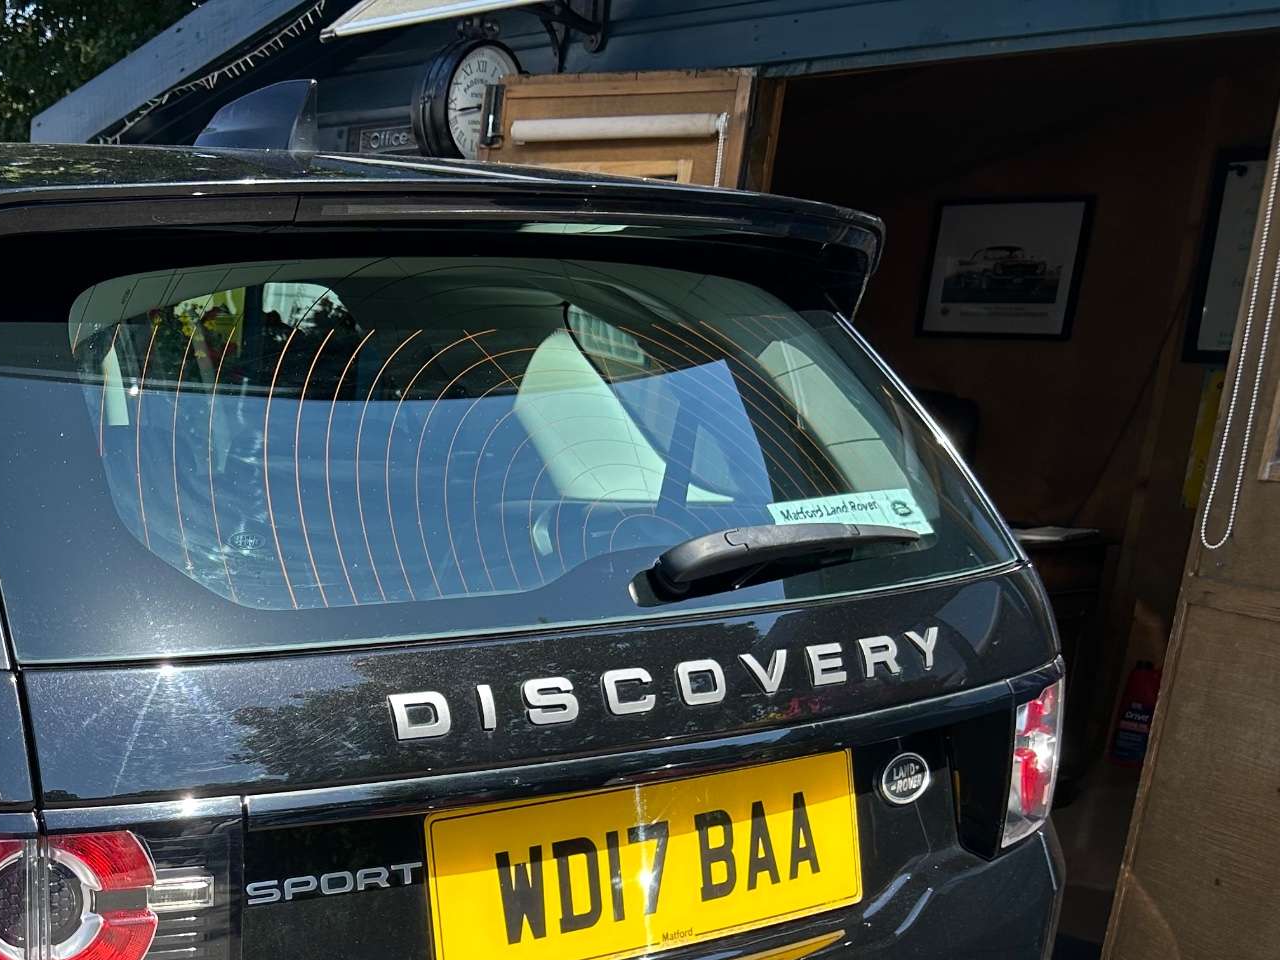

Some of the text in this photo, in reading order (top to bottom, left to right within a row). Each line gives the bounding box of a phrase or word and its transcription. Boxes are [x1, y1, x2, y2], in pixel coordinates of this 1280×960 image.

[370, 131, 408, 148] Office
[824, 503, 849, 516] Land
[849, 500, 880, 512] Rover
[388, 626, 939, 742] DISCOVERY
[496, 790, 821, 944] WD17 BAA
[246, 861, 423, 905] SPORT
[661, 927, 693, 942] Matford
